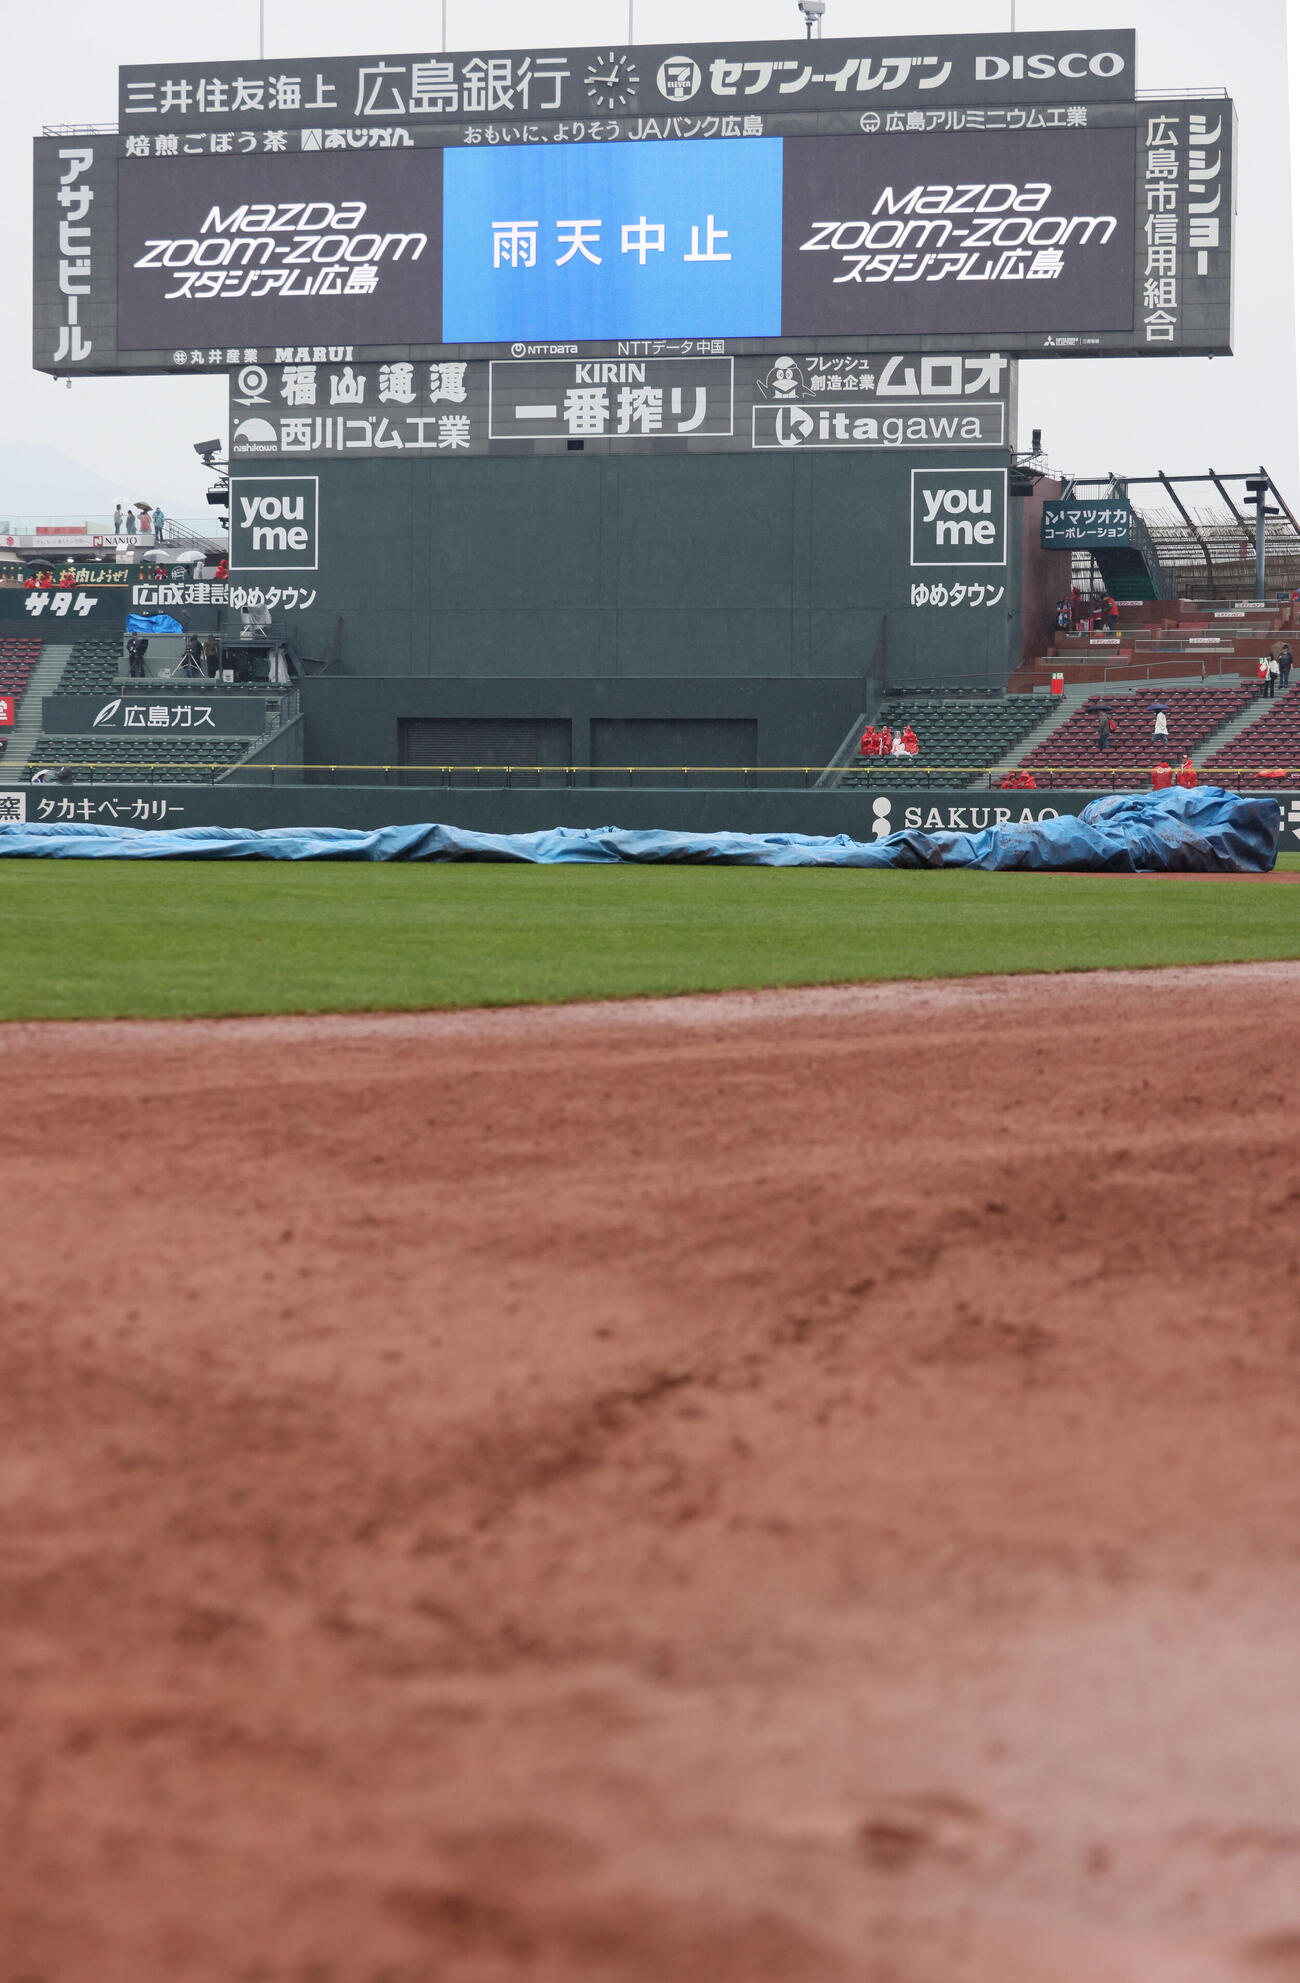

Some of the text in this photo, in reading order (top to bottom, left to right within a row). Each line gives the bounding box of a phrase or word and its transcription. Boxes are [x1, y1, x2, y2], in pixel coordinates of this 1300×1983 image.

[976, 53, 1124, 80] DISCO
[126, 74, 337, 113] 三井住友海上
[355, 54, 571, 116] 広島銀行
[667, 66, 691, 96] 7
[464, 115, 764, 144] おもいに、よりそう JAバンク広島
[886, 106, 1087, 131] 広島アルミニウム工業
[126, 130, 288, 156] 焙煎ごぼう茶
[325, 128, 414, 148] あじかん
[1189, 115, 1221, 275] シシンヨー
[1144, 115, 1179, 341] 広島市信用組合
[492, 215, 731, 268] 雨天中止
[54, 149, 93, 361] アサヒビール
[833, 249, 1066, 283] スタジアム広島
[163, 265, 380, 299] スタジアム広島
[191, 349, 257, 364] 丸井産業
[275, 347, 353, 362] MARUI
[805, 356, 870, 372] フレッシュ
[281, 362, 467, 406] 福山通運
[576, 364, 645, 383] KIRIN
[810, 374, 875, 392] 創造企業
[877, 353, 1008, 396] ムロオ
[515, 387, 705, 435] 一番搾り
[280, 415, 470, 451] 西川ゴム工業
[240, 496, 305, 529] you
[922, 489, 992, 522] you
[1067, 509, 1126, 524] マツオカ
[252, 527, 309, 551] me
[935, 520, 996, 545] me
[1046, 527, 1126, 538] コーポレーション
[25, 593, 98, 616] サタケ
[230, 586, 317, 612] ゆめタウン
[911, 583, 1004, 607] ゆめタウン
[124, 705, 215, 727] 広島ガス
[37, 798, 185, 821] タカキベーカリー
